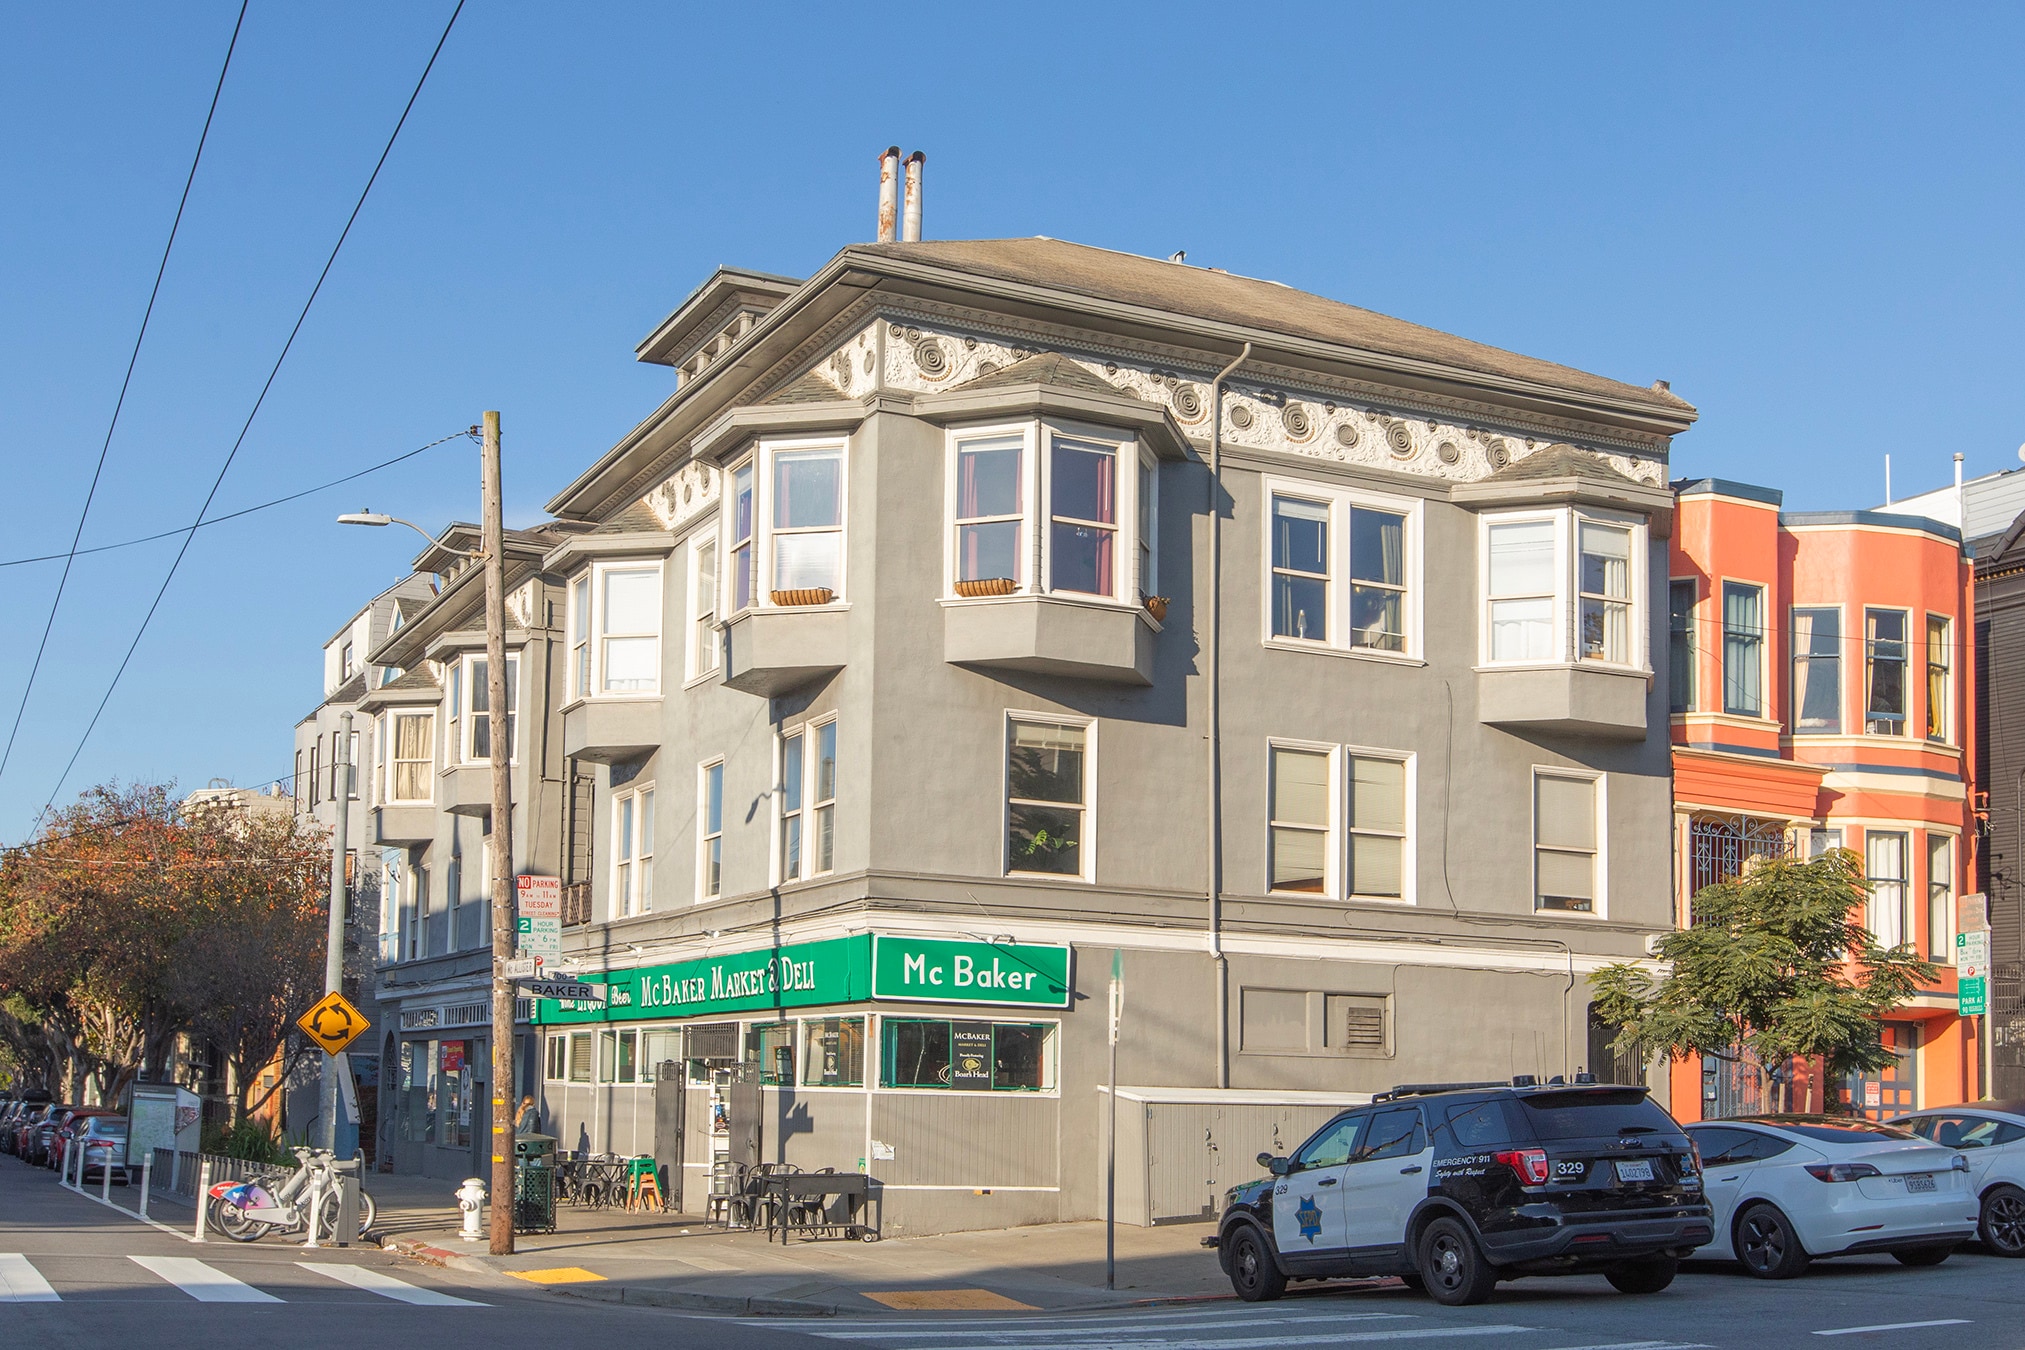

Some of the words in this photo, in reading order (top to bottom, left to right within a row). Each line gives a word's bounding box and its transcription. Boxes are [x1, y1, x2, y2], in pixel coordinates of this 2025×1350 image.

[519, 877, 530, 888] NO
[532, 879, 559, 889] PARKING
[525, 901, 553, 909] TUESDAY
[519, 920, 530, 931] 2
[1959, 935, 1964, 946] 2
[903, 952, 943, 985] Mc
[954, 955, 1037, 991] Baker
[532, 984, 590, 998] BAKER
[1961, 997, 1976, 1005] PARK
[1977, 996, 1983, 1004] AT
[1433, 1157, 1476, 1168] EMERGENCY
[1478, 1155, 1490, 1163] 911
[1557, 1162, 1585, 1175] 329
[1275, 1184, 1289, 1195] 329
